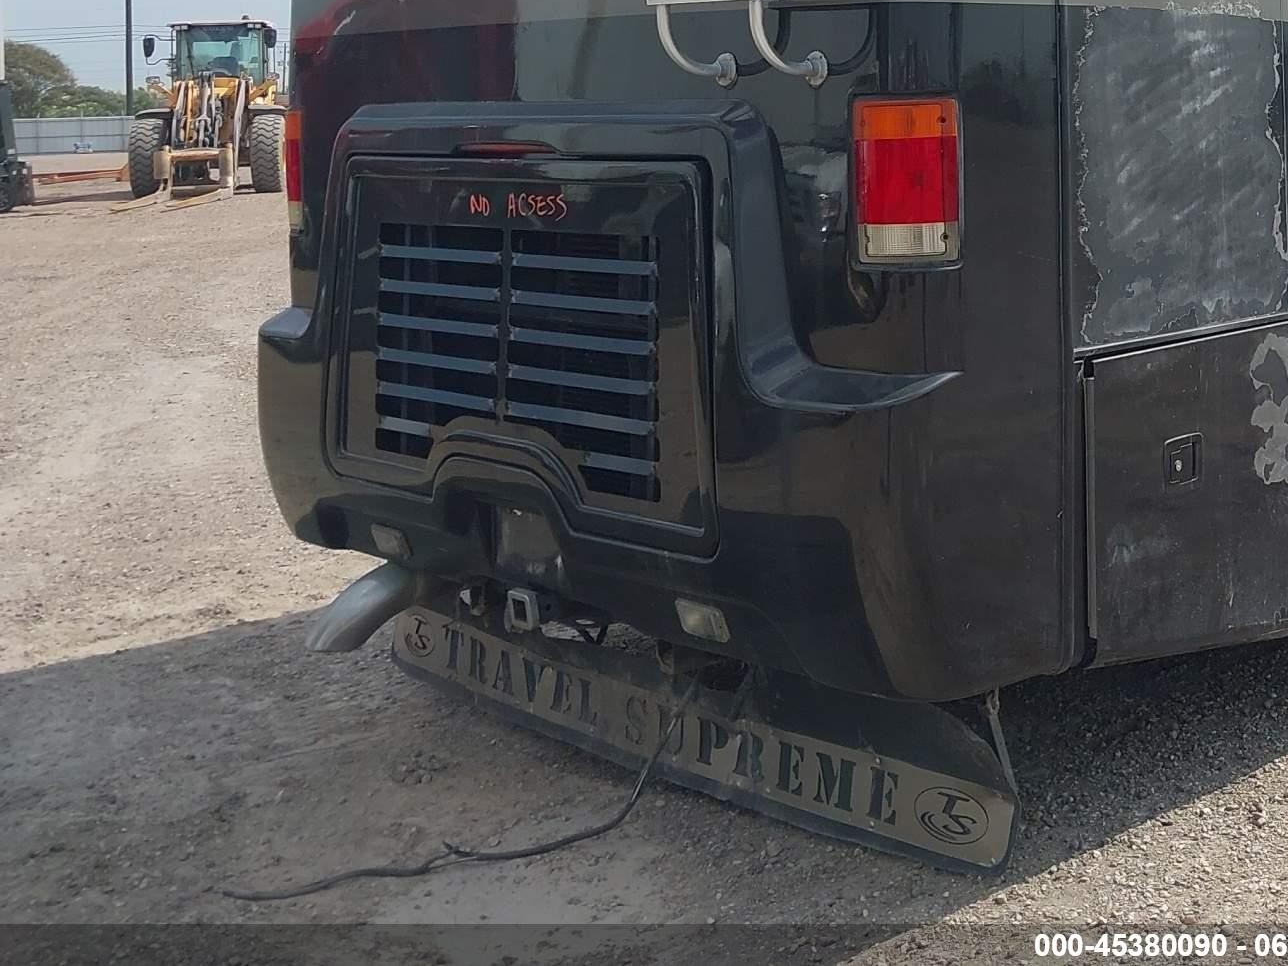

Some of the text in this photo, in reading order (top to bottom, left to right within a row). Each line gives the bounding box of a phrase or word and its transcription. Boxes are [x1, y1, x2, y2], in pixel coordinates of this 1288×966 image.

[470, 192, 567, 221] NO ACSESS
[442, 623, 899, 826] TRAVEL SUPREME
